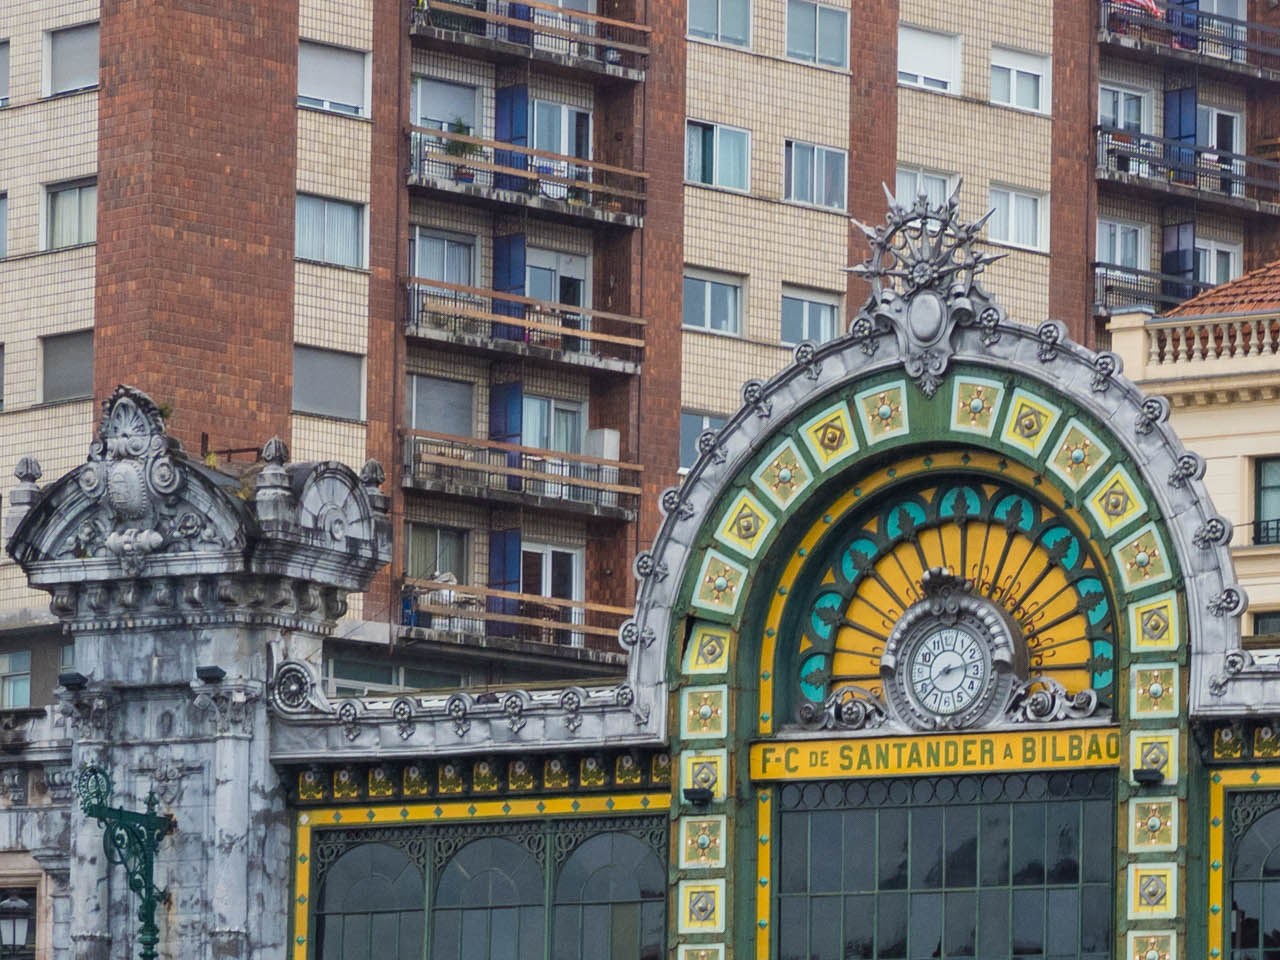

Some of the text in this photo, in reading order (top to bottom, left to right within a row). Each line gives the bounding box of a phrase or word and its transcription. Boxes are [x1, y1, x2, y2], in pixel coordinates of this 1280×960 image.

[922, 651, 931, 663] 10
[809, 750, 829, 767] DE
[839, 738, 994, 771] SANTANDER
[1003, 743, 1013, 760] A
[1022, 732, 1120, 764] BILBAO
